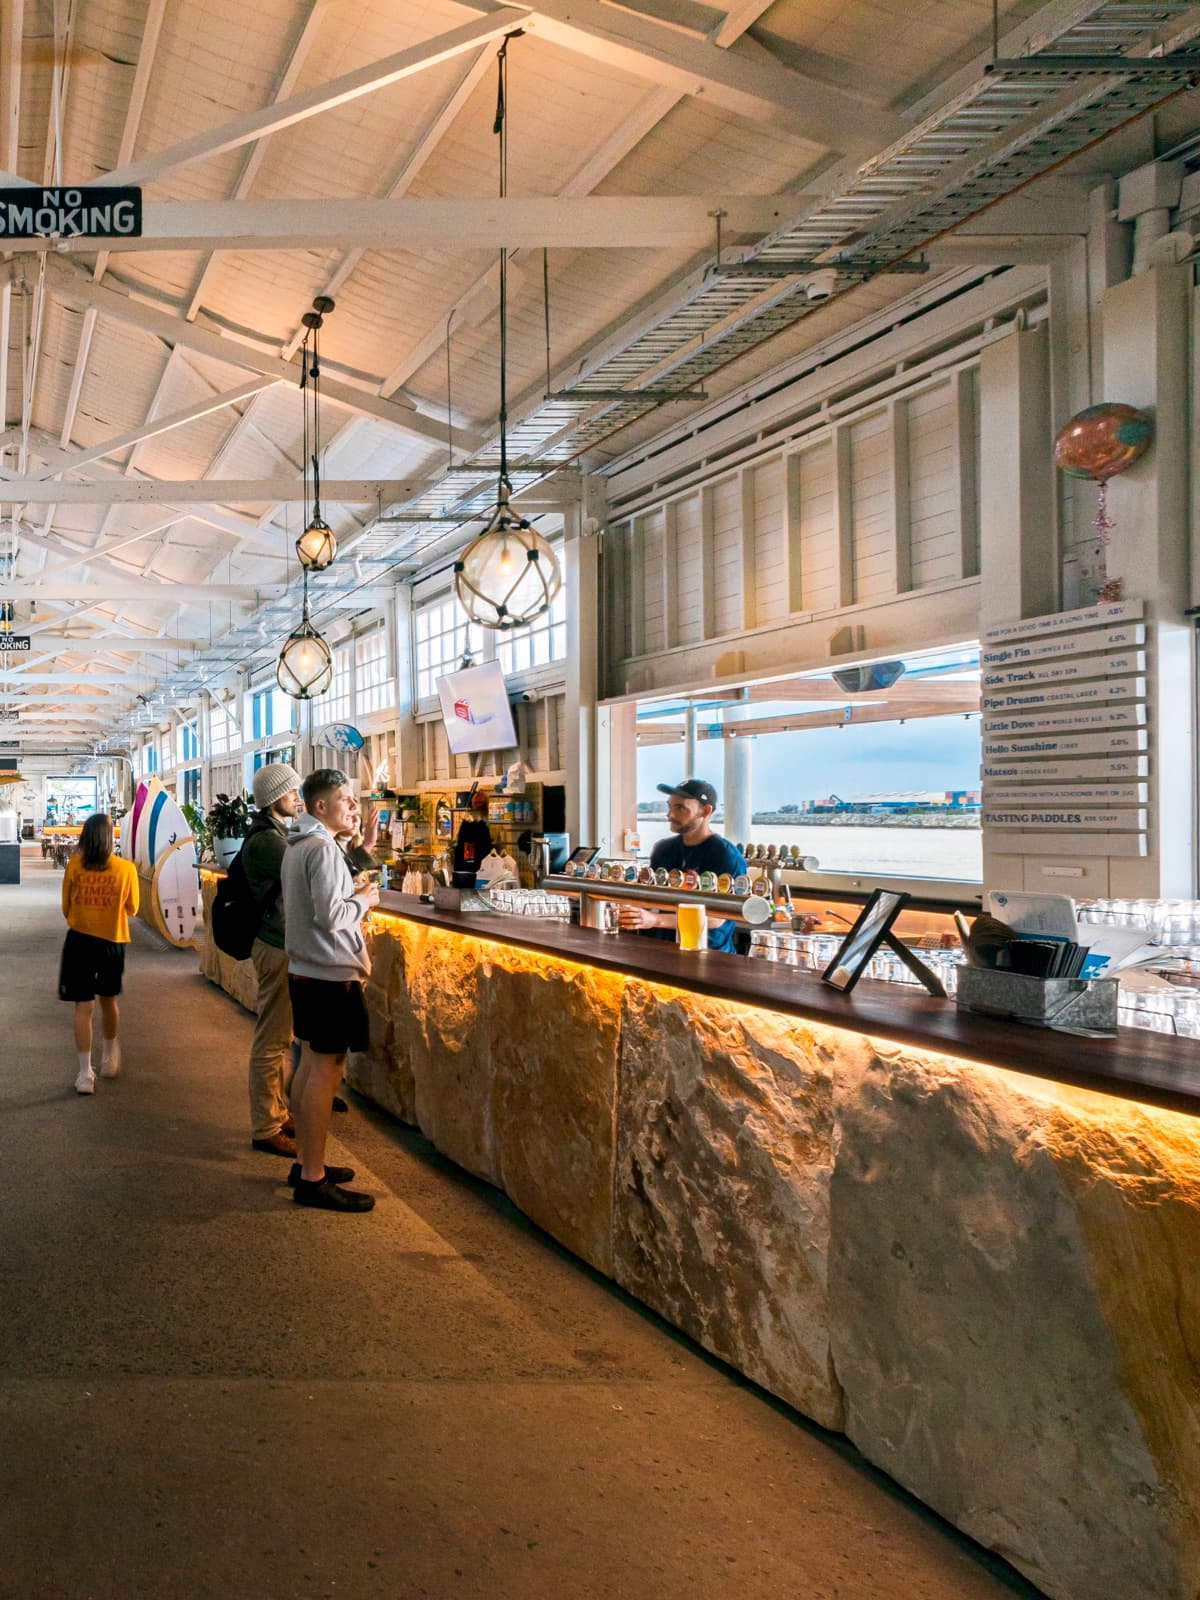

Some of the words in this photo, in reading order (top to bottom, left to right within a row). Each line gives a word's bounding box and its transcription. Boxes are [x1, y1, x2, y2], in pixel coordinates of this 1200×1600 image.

[42, 190, 82, 207] NO
[984, 650, 1012, 662] Single
[1014, 647, 1031, 657] Fin
[984, 675, 1004, 685] Side
[1006, 671, 1036, 682] Track
[984, 698, 1004, 709] Pipe
[1007, 696, 1045, 706] Dreams
[984, 722, 1009, 731] Little
[1011, 720, 1035, 729] Dove
[985, 744, 1009, 754] Hello
[1010, 742, 1057, 752] Sunshine
[985, 814, 1029, 823] TASTING
[1031, 814, 1081, 823] PADDLES
[77, 874, 117, 885] GOOD
